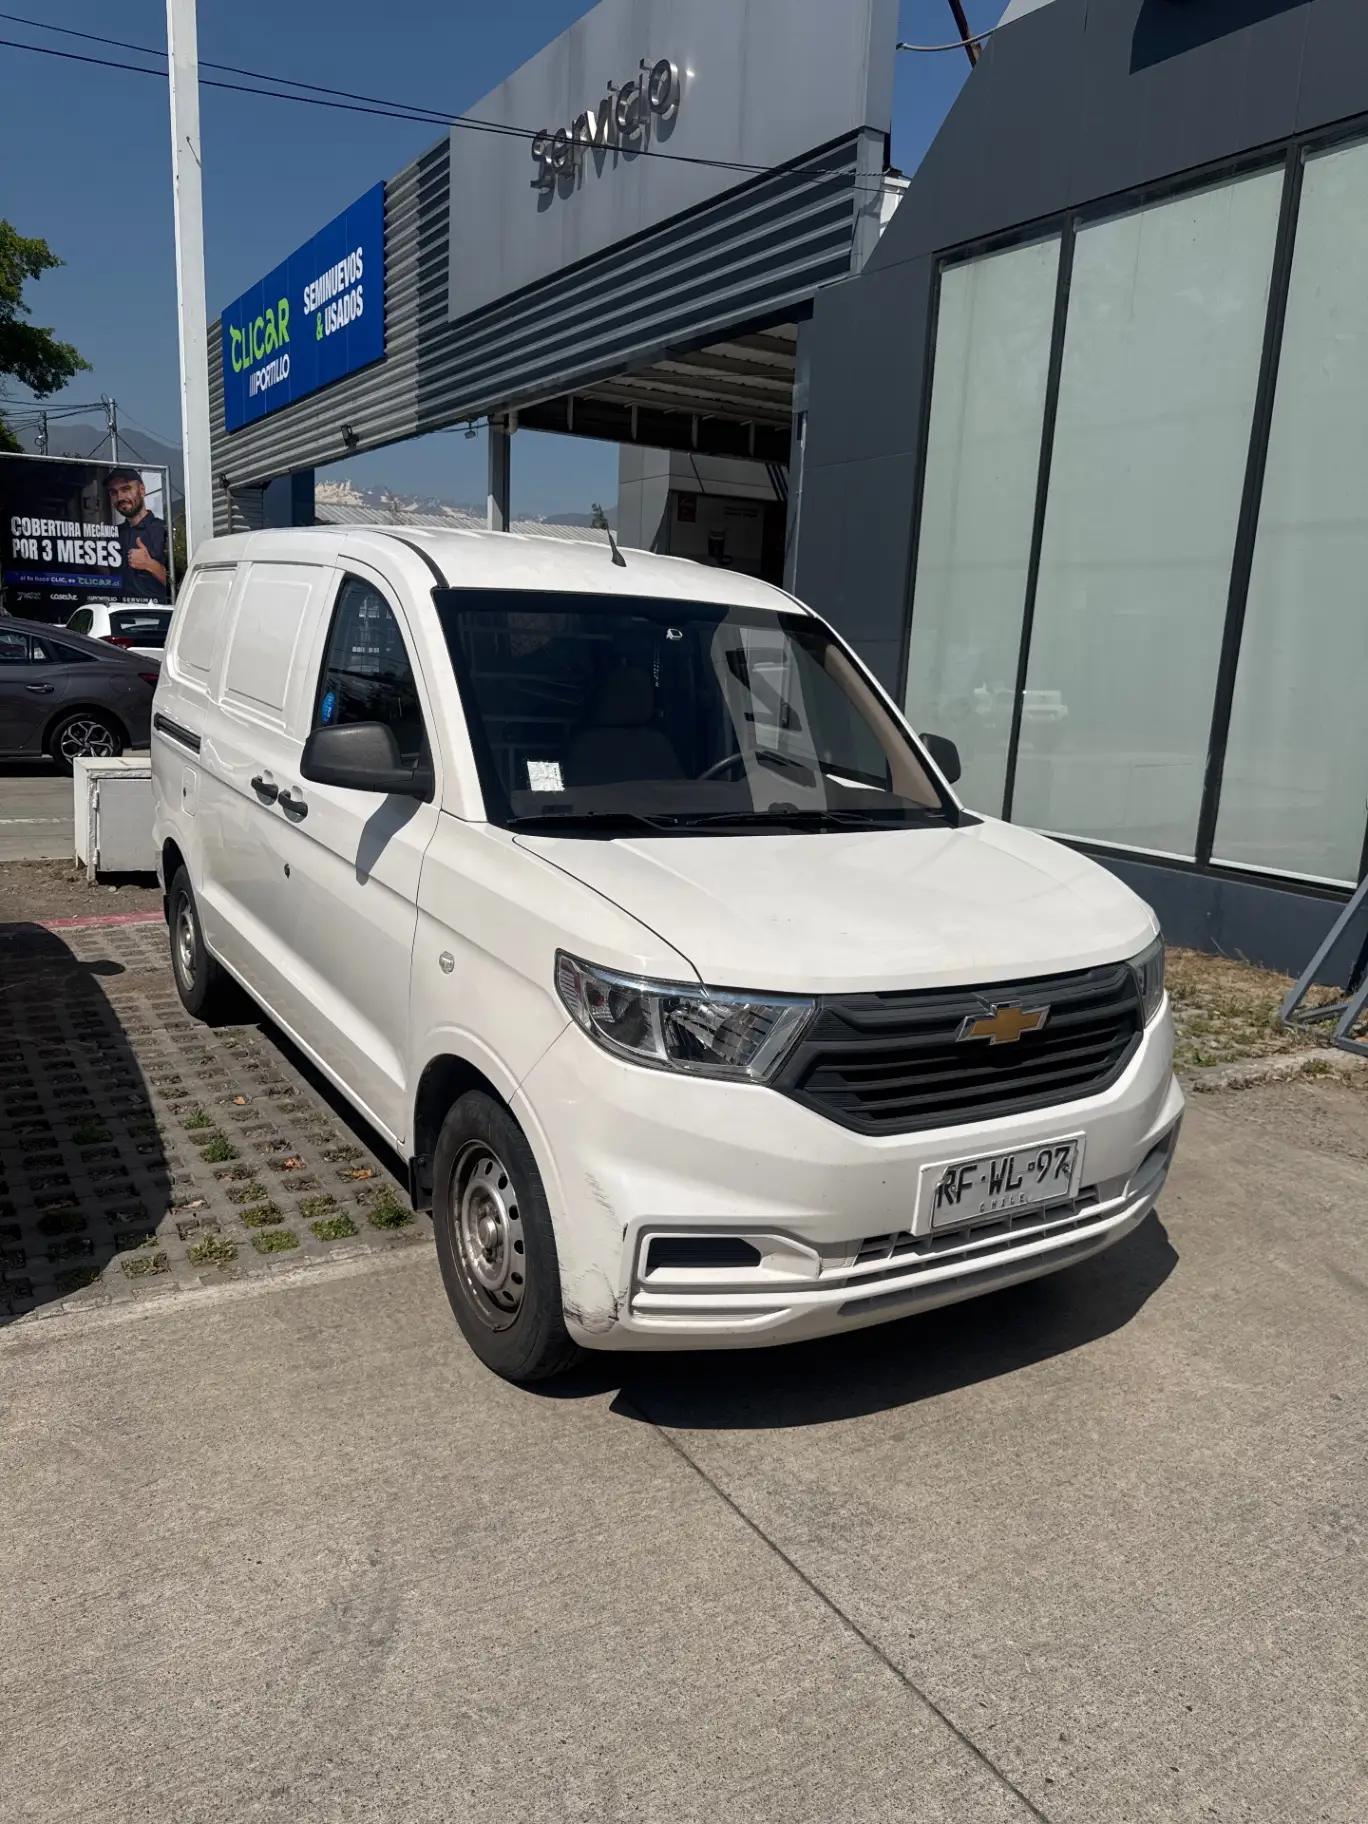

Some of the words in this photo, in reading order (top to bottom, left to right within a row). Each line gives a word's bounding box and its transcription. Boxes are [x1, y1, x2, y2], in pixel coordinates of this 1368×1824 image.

[530, 58, 679, 189] servicio
[303, 246, 363, 315] SEMINUEVOS
[315, 312, 324, 341] &
[324, 285, 364, 336] USADOS
[10, 516, 81, 537] COBERTURA
[83, 522, 120, 538] MECÁNICA
[12, 538, 39, 560] POR
[42, 539, 53, 562] 3
[56, 540, 122, 568] MESES
